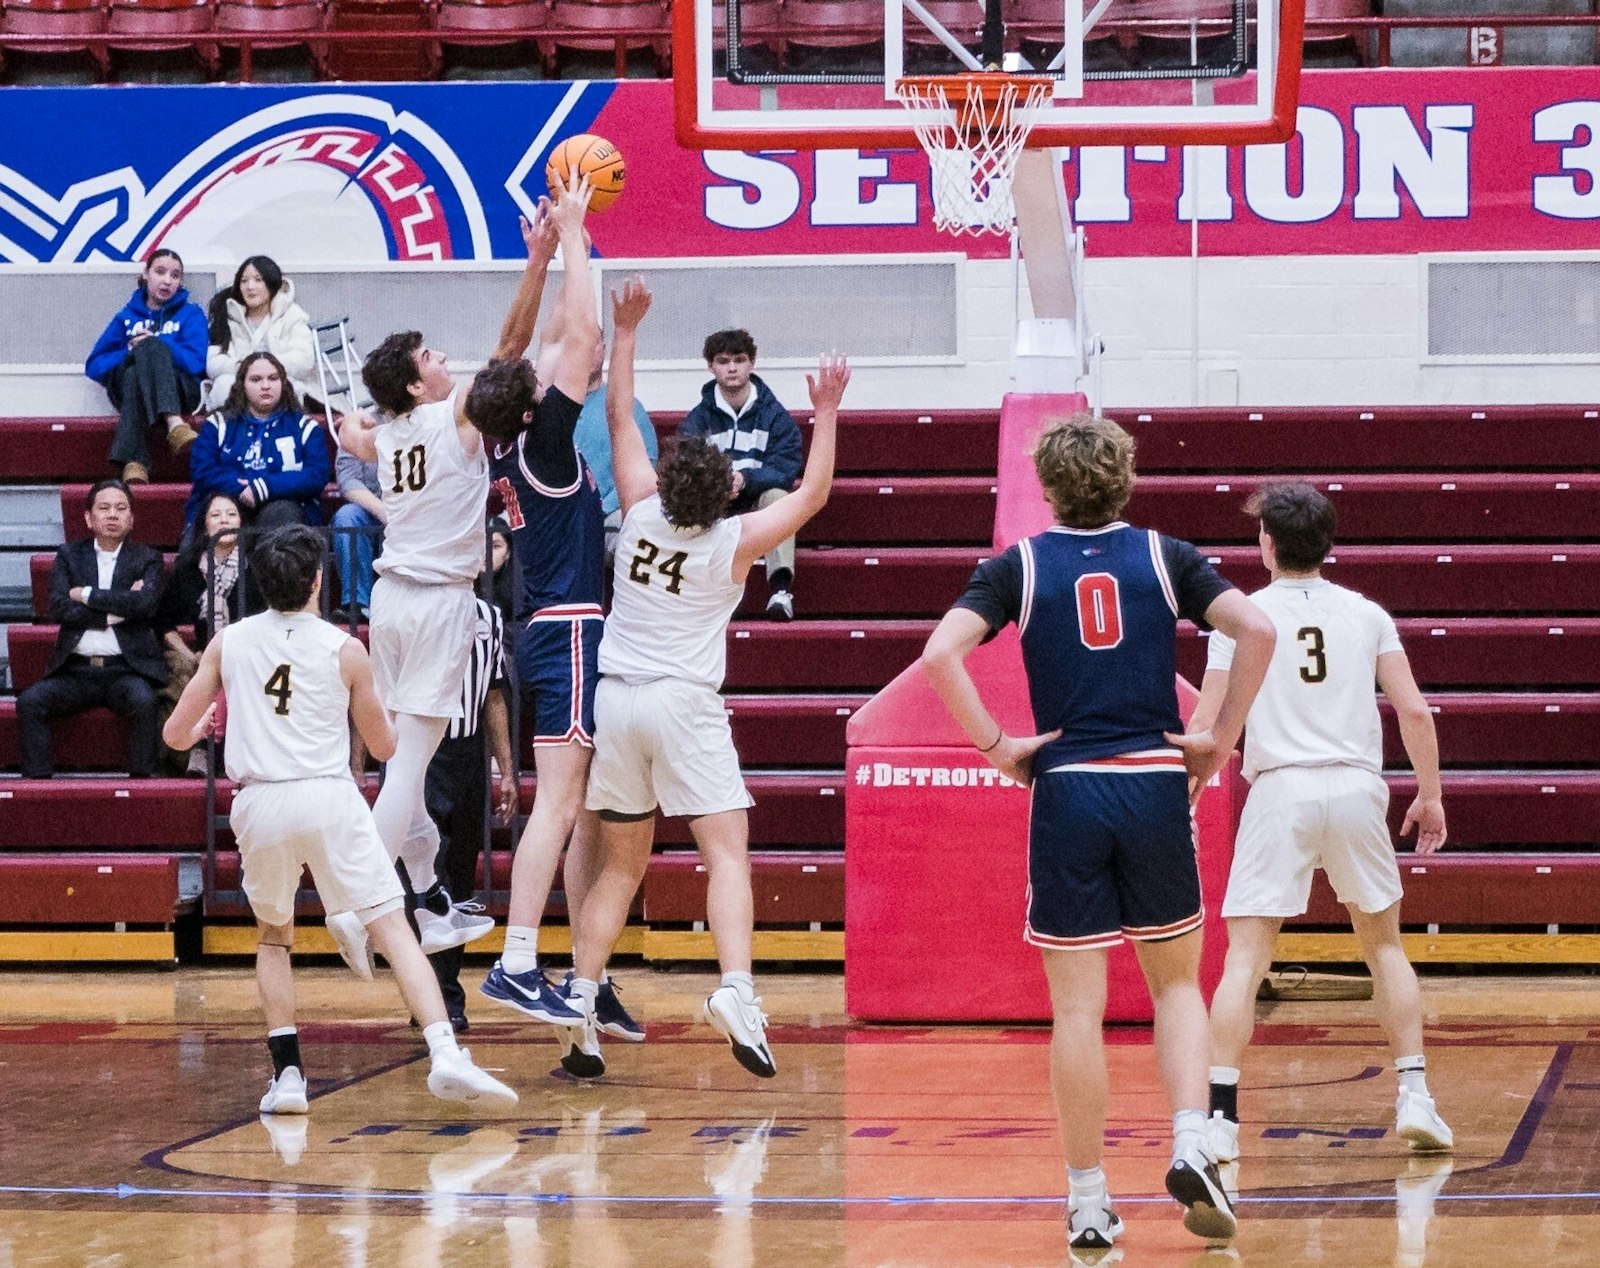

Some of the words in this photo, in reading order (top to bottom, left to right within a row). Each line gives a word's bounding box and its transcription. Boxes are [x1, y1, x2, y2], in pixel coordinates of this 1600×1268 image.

[1471, 26, 1499, 65] B
[1533, 100, 1600, 219] 3
[275, 435, 304, 472] L
[391, 443, 427, 494] 10
[629, 538, 689, 596] 24
[1074, 571, 1124, 651] 0
[1297, 626, 1328, 684] 3
[264, 663, 293, 716] 4
